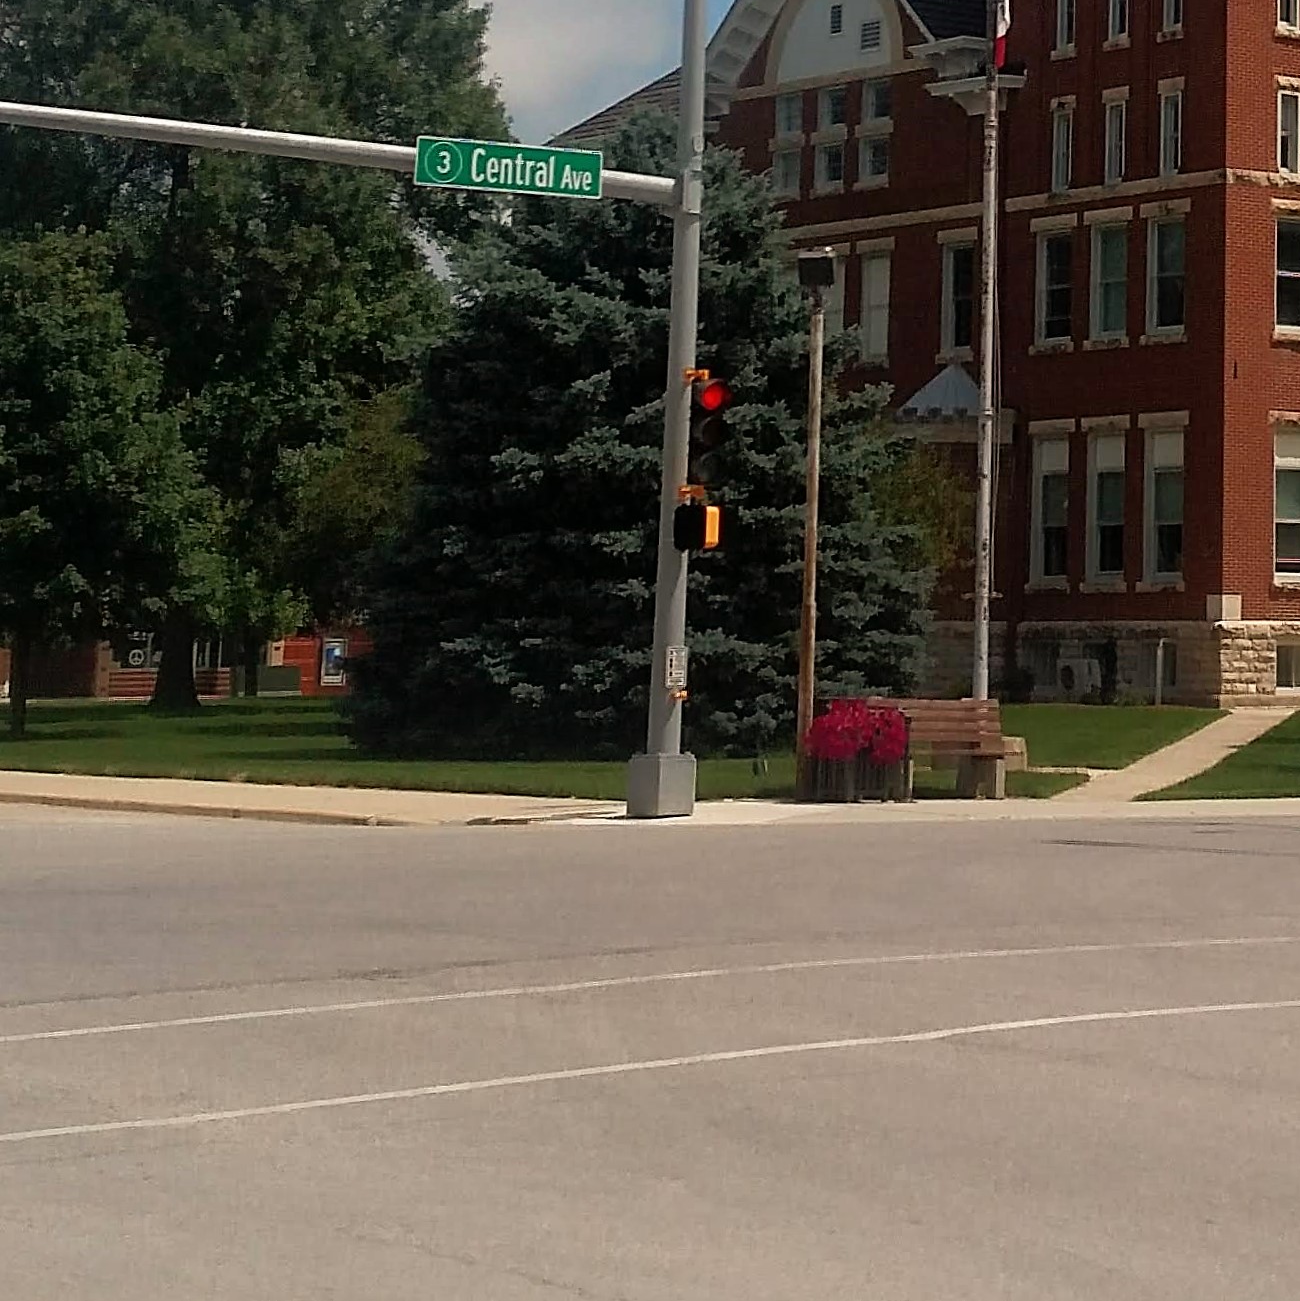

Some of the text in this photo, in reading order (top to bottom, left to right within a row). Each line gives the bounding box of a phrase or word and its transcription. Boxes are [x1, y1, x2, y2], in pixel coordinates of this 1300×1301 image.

[436, 147, 592, 191] 3 Central Ave
